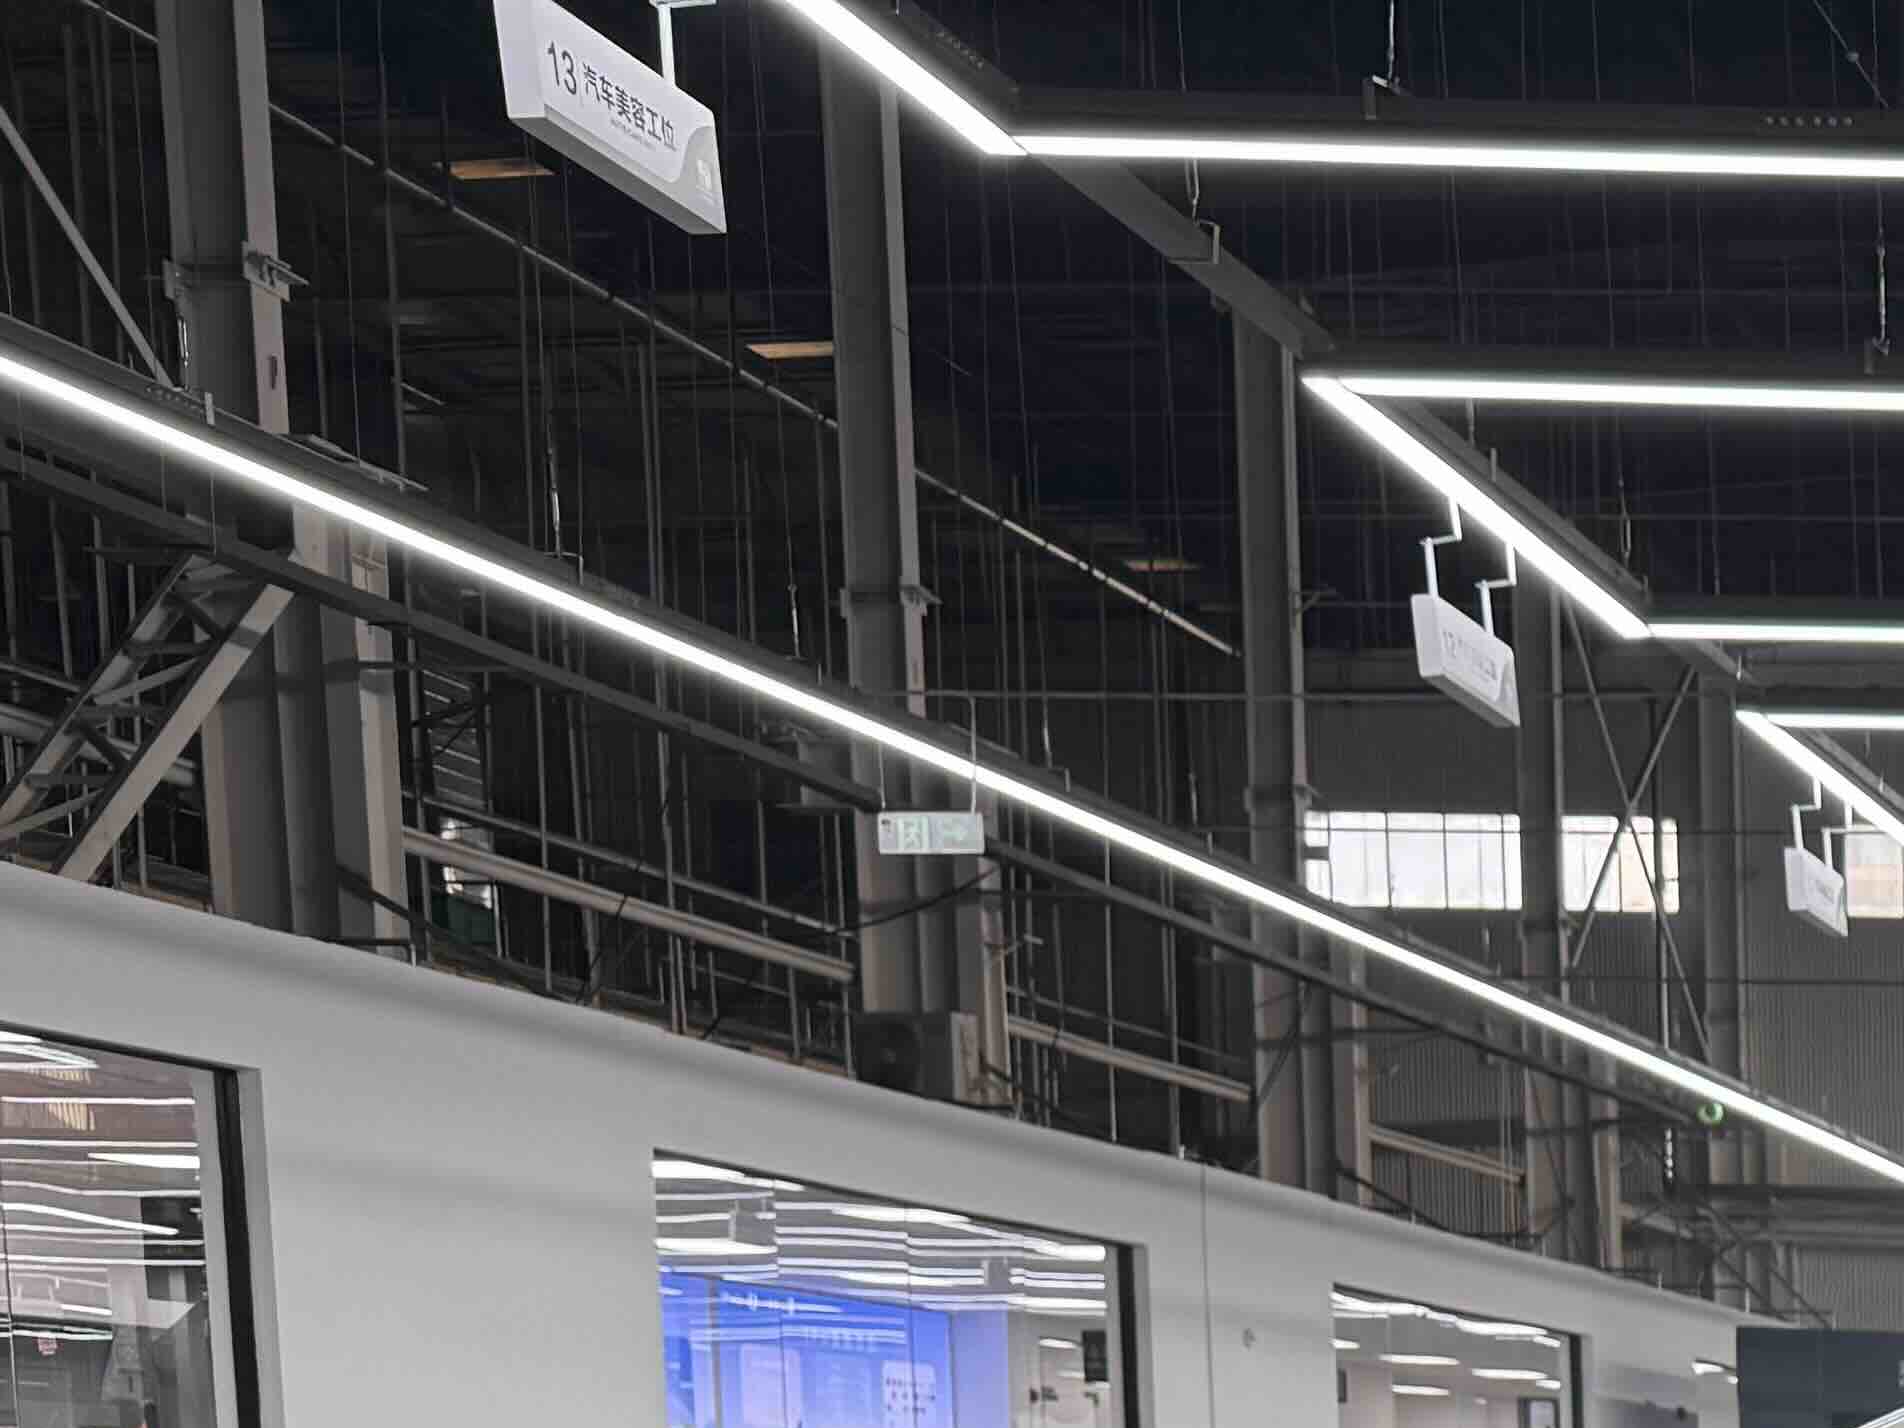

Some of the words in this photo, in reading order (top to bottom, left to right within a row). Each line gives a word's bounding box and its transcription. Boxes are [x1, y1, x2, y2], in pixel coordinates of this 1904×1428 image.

[547, 41, 577, 95] 13
[582, 61, 678, 152] 汽车美容工位
